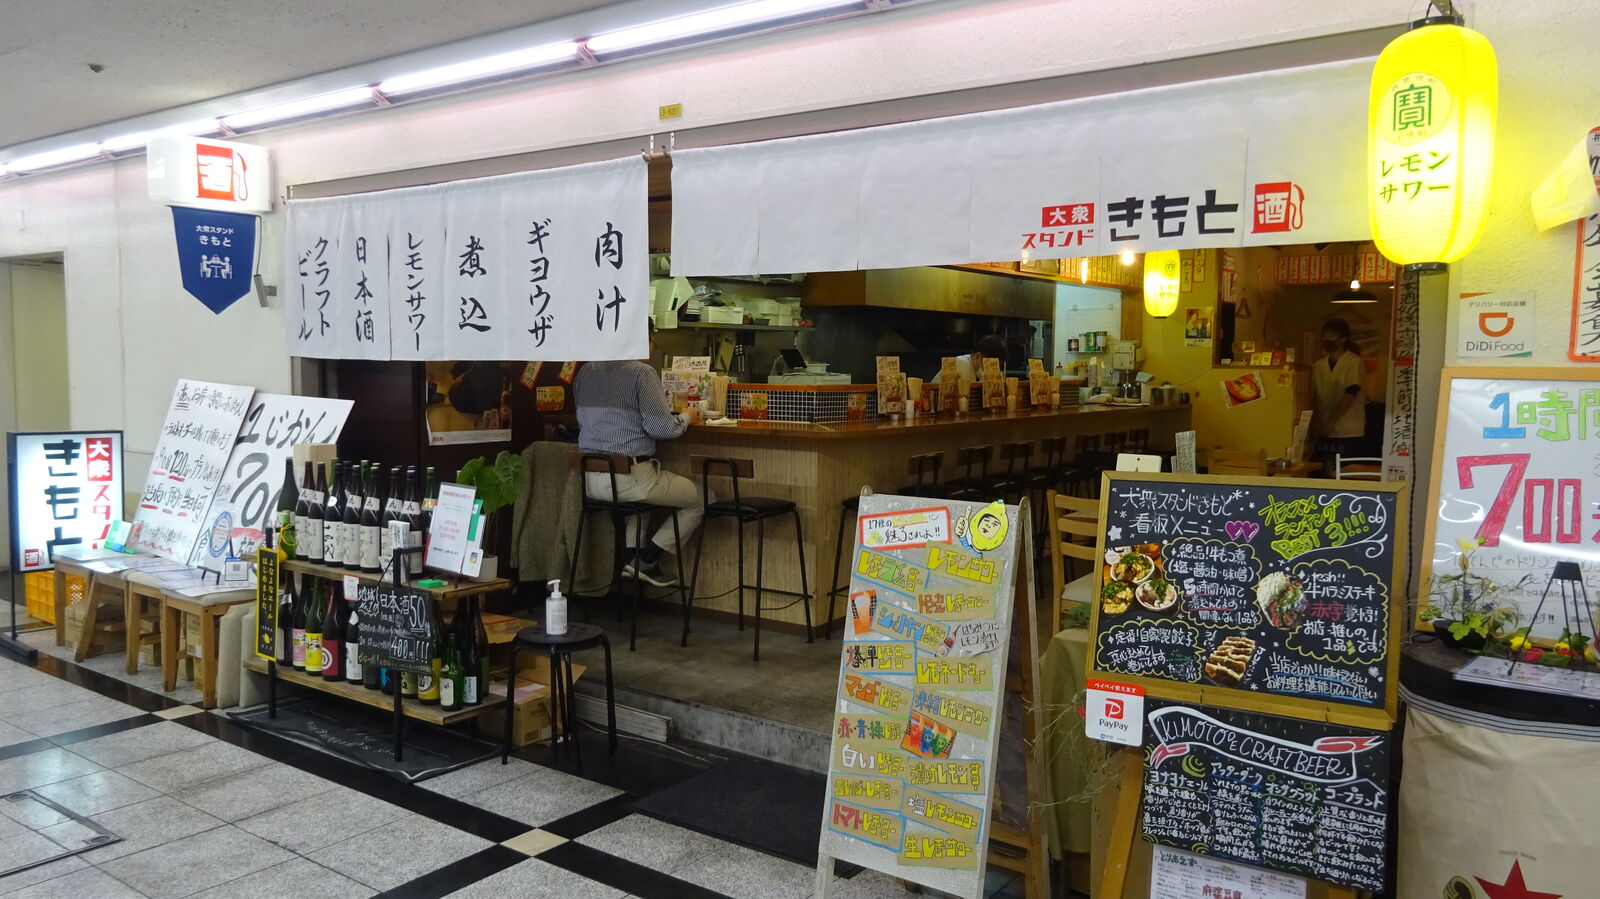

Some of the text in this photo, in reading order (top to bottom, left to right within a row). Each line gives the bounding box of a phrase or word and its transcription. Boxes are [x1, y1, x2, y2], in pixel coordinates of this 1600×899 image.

[1381, 151, 1451, 177] レモン
[1256, 192, 1288, 225] 酒
[1379, 180, 1450, 204] サワー
[1049, 204, 1090, 225] 大衆
[1107, 189, 1239, 242] きもと
[199, 236, 232, 247] きもと
[1021, 229, 1095, 250] スタンド
[315, 236, 332, 337] クラフト
[354, 236, 375, 344] 日本酒
[406, 232, 426, 352] レモンサワー
[459, 235, 492, 333] 煮込
[594, 221, 626, 332] 肉汁
[299, 251, 312, 341] ビール
[1495, 341, 1524, 351] Food
[1099, 718, 1129, 731] PayPay
